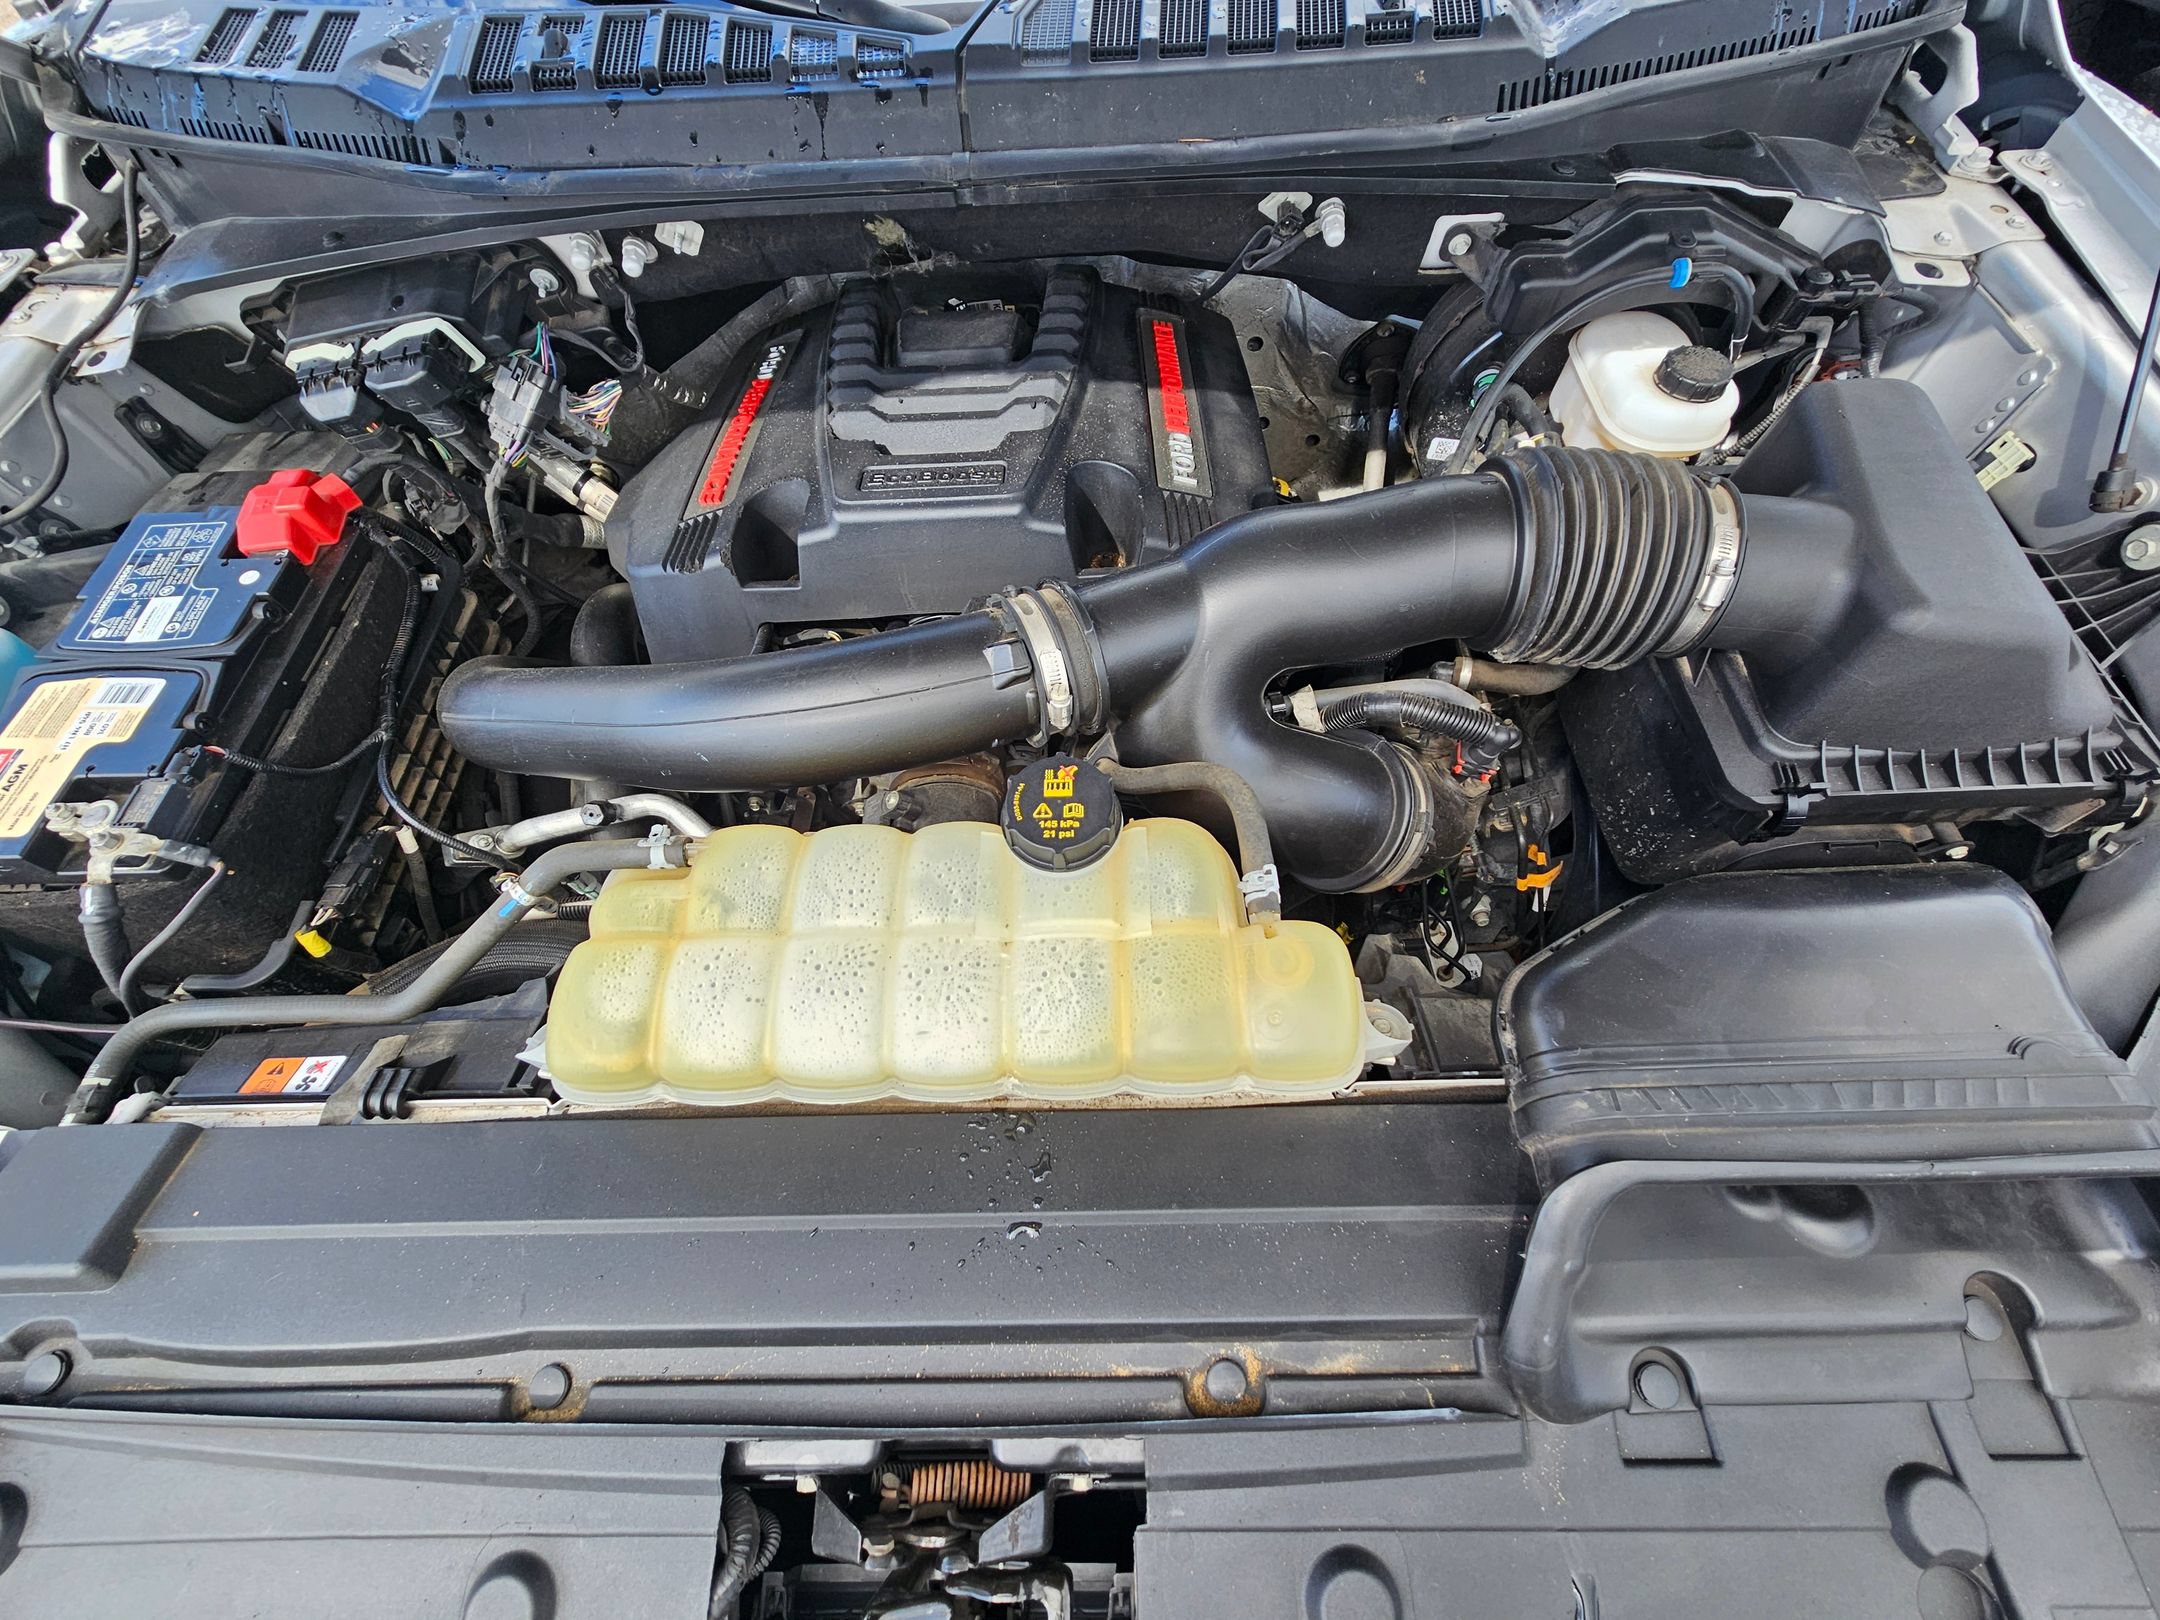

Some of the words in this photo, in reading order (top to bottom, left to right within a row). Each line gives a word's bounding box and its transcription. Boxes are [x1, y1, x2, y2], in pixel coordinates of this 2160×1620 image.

[1152, 319, 1191, 436] PERFORMANCE
[1168, 431, 1200, 487] FORD
[3, 764, 28, 792] AGM
[1039, 820, 1058, 828] 145
[1060, 820, 1080, 828] kPa
[1043, 830, 1056, 838] 21
[1059, 830, 1075, 839] psi
